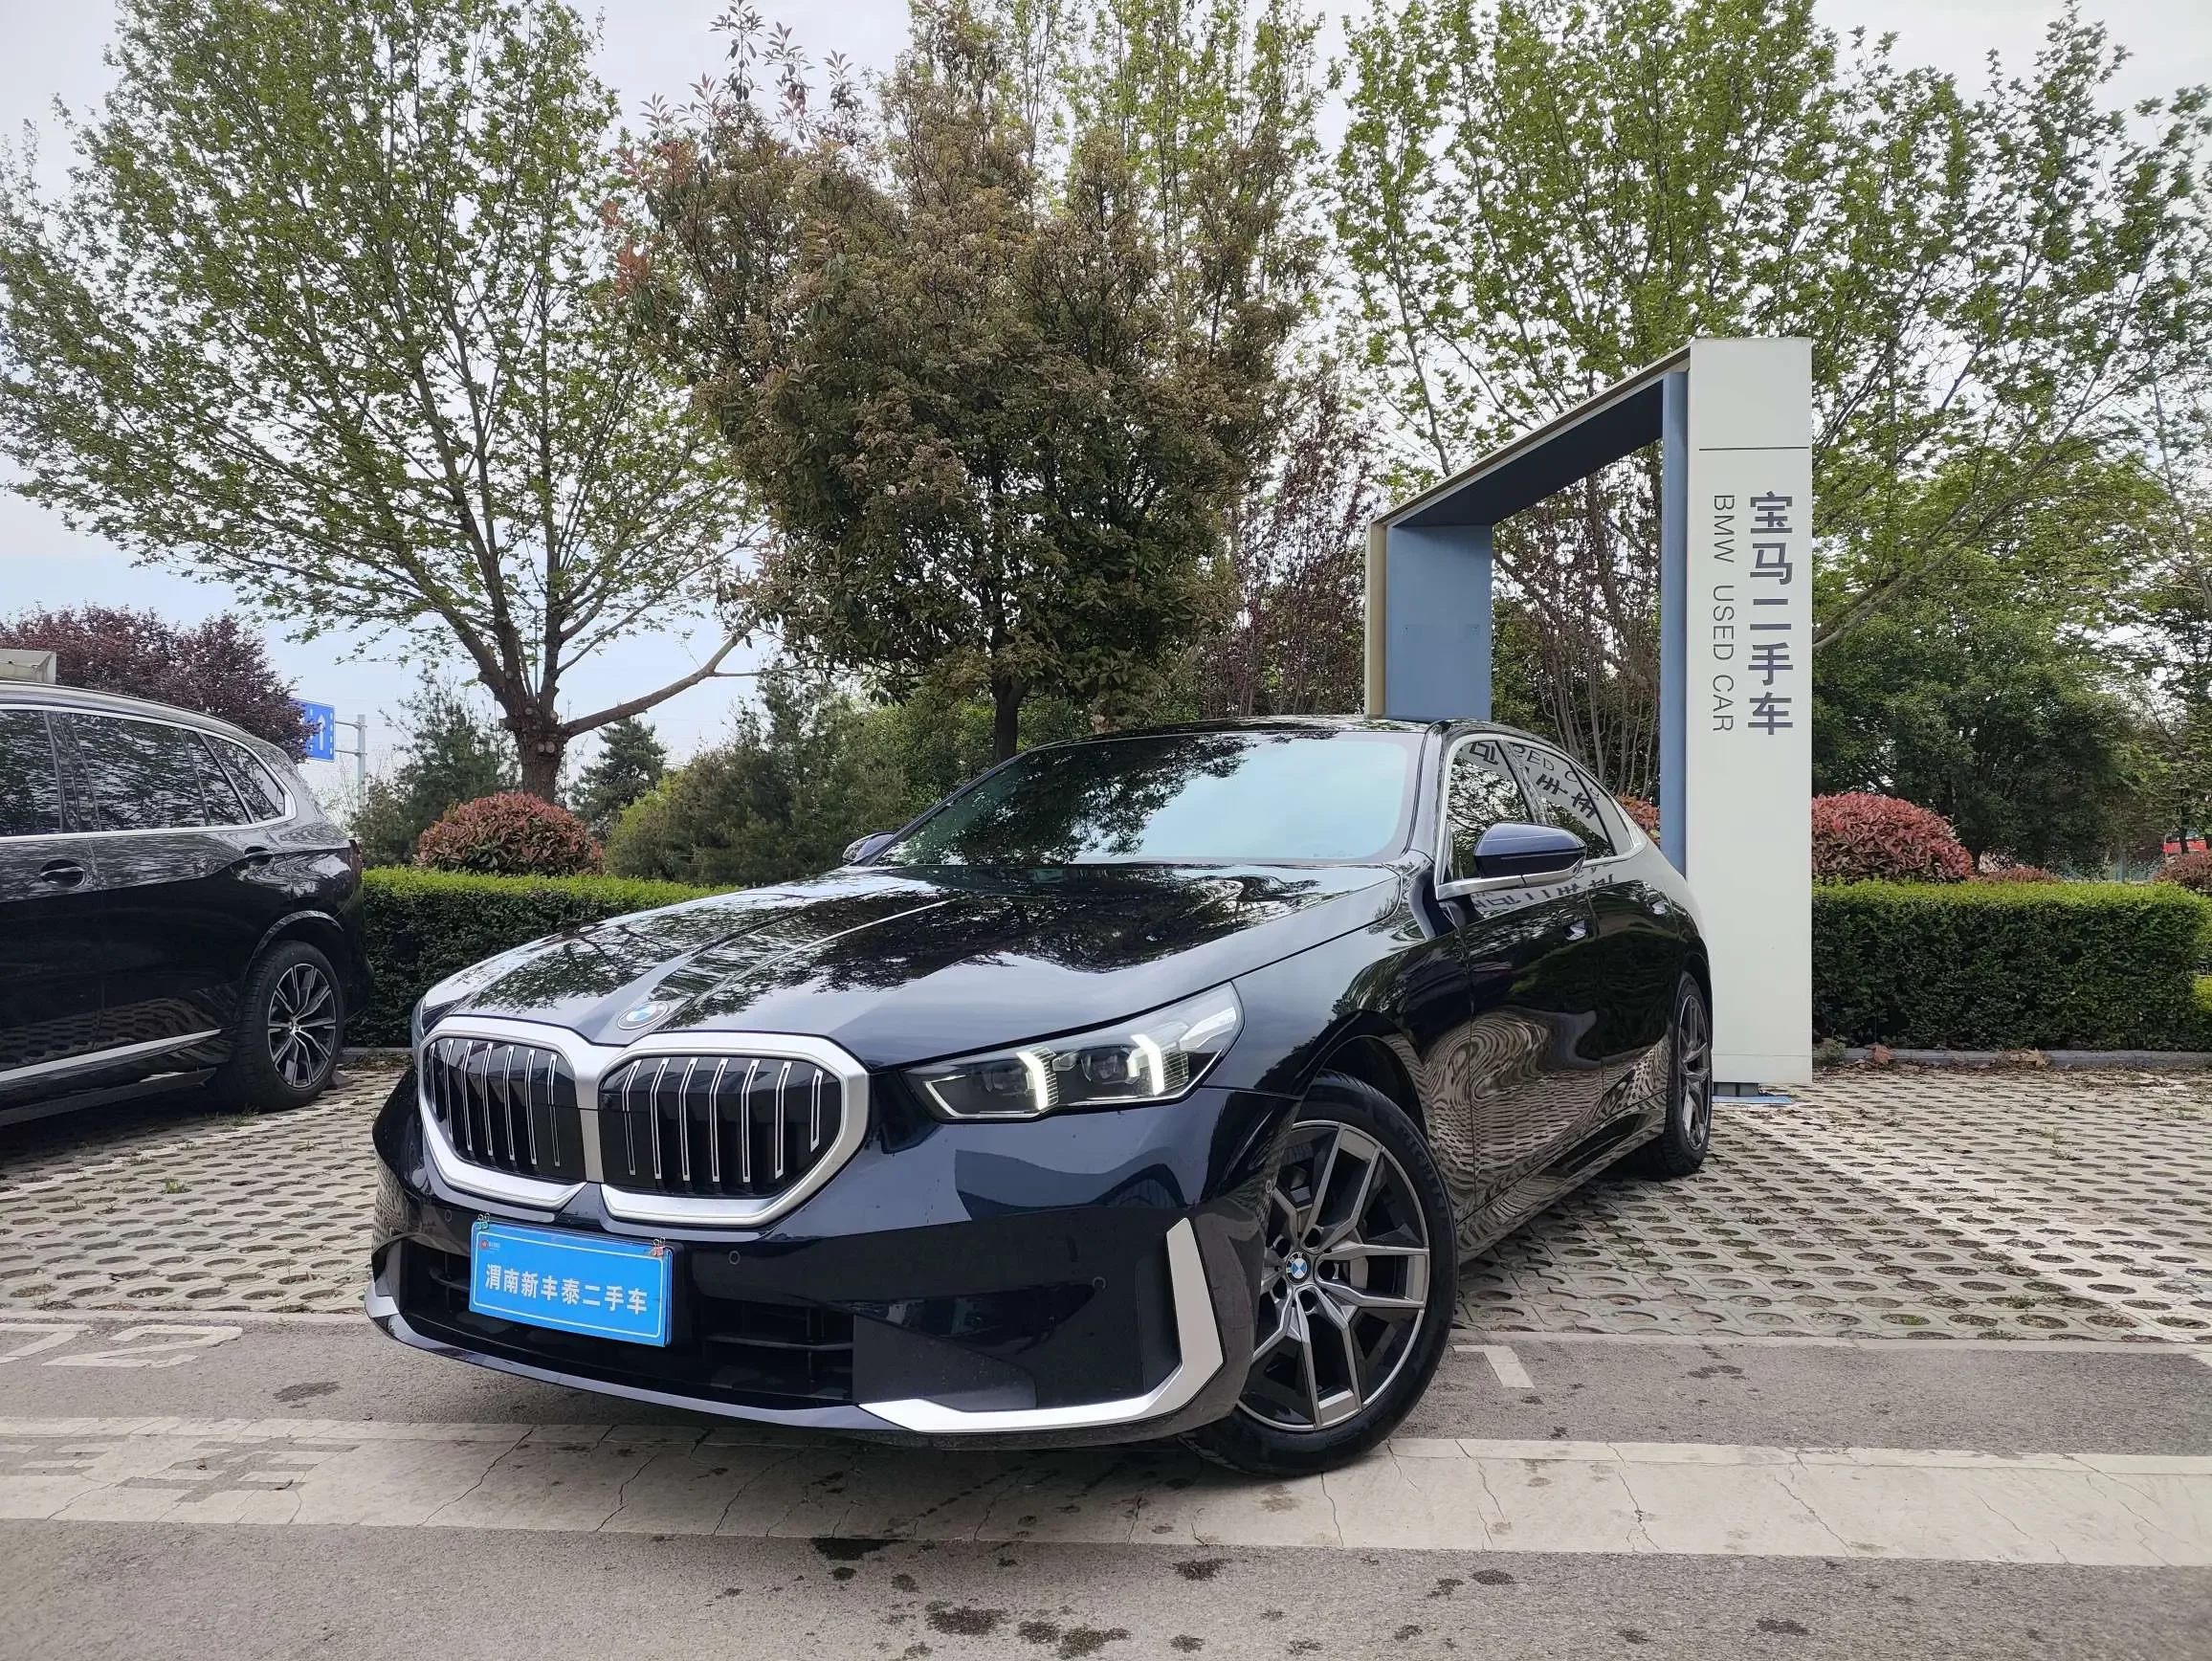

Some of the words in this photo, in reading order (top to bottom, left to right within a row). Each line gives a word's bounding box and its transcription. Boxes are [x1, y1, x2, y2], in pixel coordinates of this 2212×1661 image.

[1713, 495, 1736, 563] BMW
[1713, 585, 1735, 661] USED
[1747, 490, 1794, 736] 宝马二手车
[1712, 674, 1735, 732] CAR
[484, 1262, 648, 1316] 渭南新丰泰二手车
